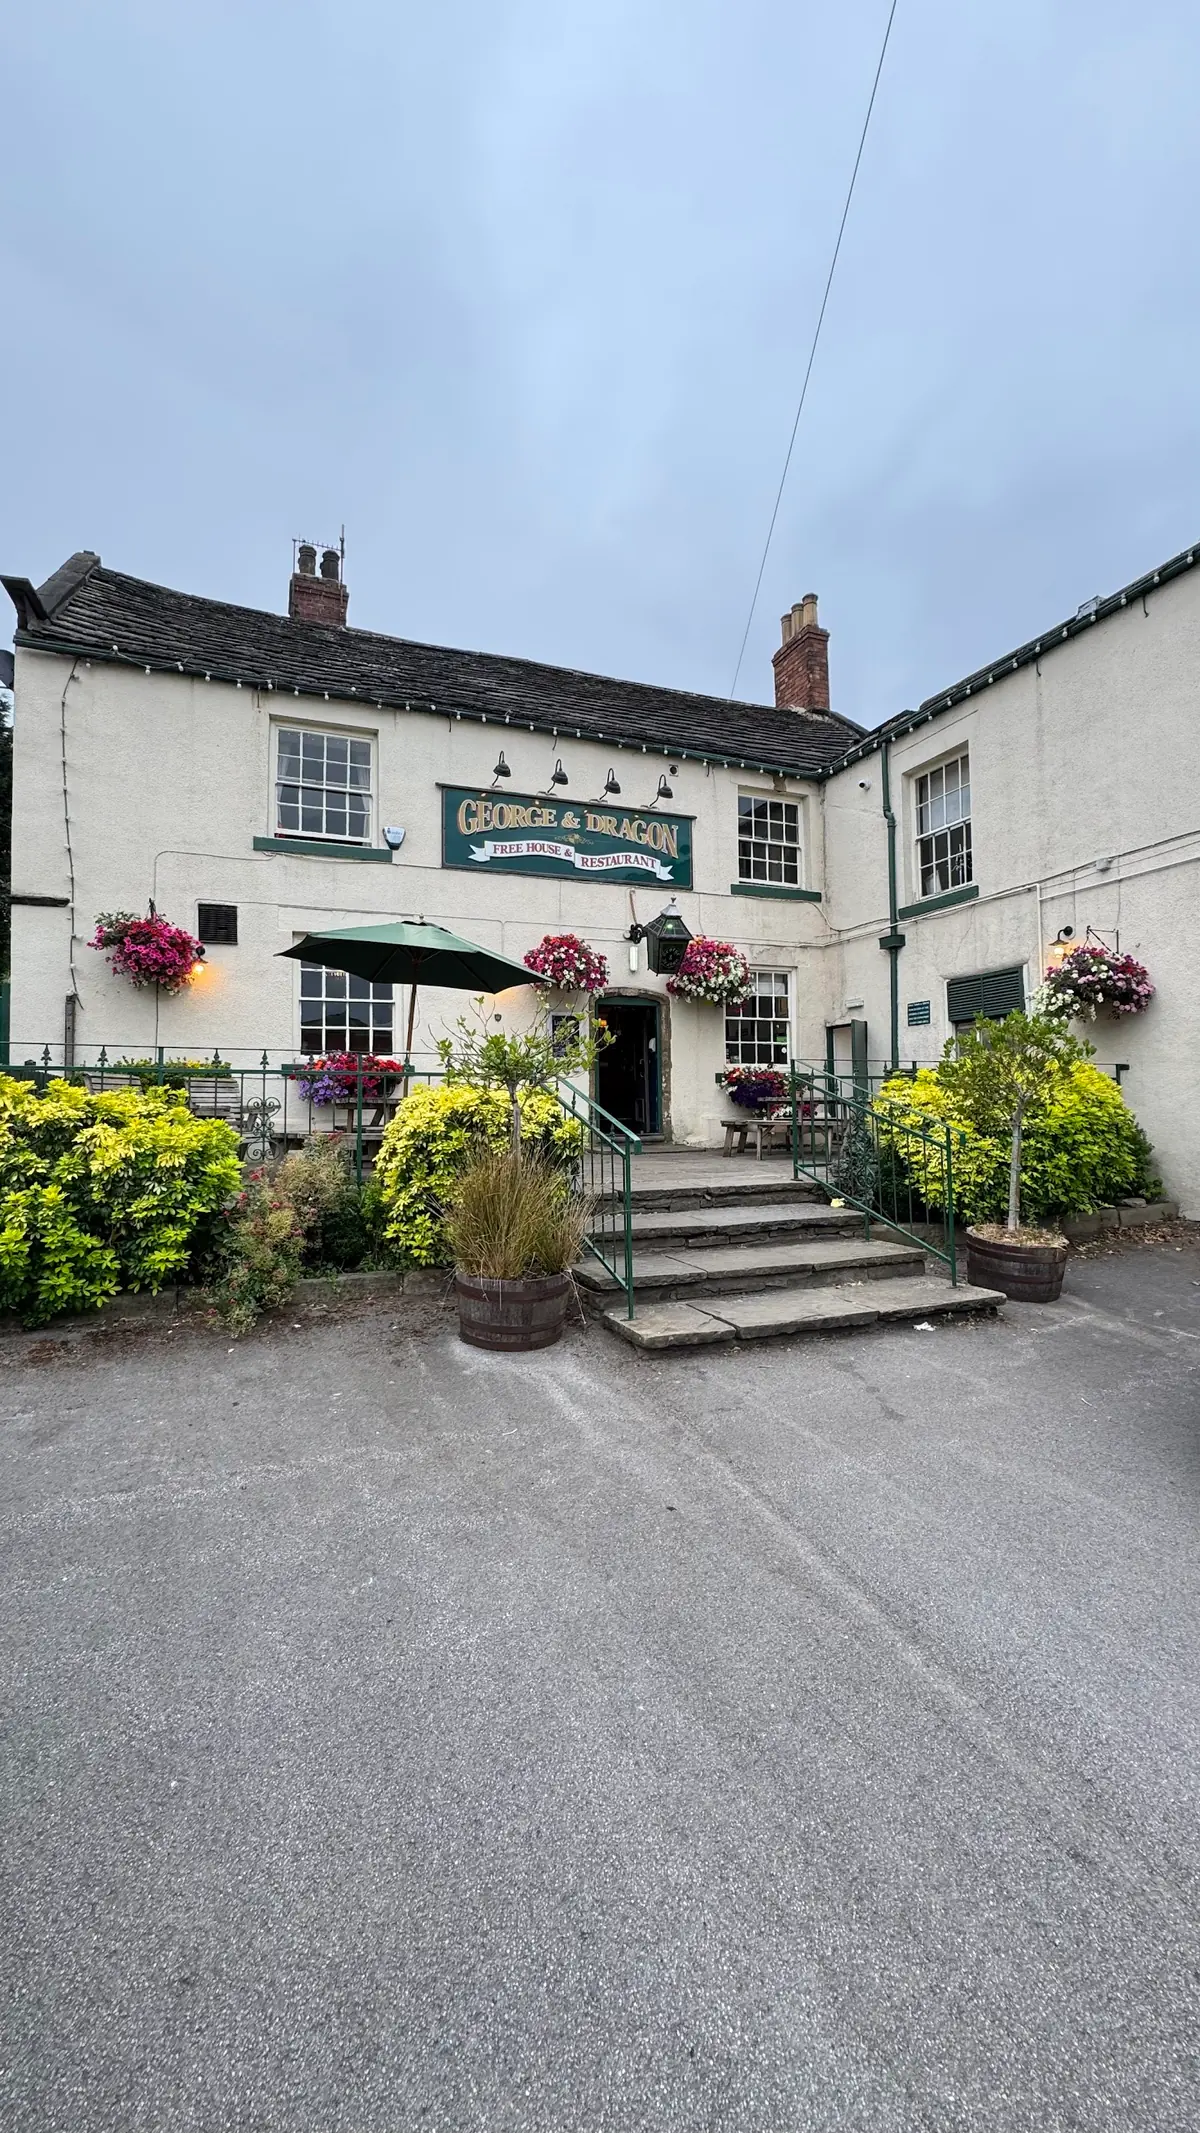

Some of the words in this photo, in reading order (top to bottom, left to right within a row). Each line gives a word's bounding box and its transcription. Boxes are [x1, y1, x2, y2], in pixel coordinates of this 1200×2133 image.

[457, 799, 558, 835] GEORGE
[561, 811, 580, 829] &
[586, 813, 679, 859] DRAGON
[493, 843, 523, 855] FREE
[526, 842, 561, 856] HOUSE
[564, 848, 573, 857] &
[581, 855, 657, 870] RESTAURANT
